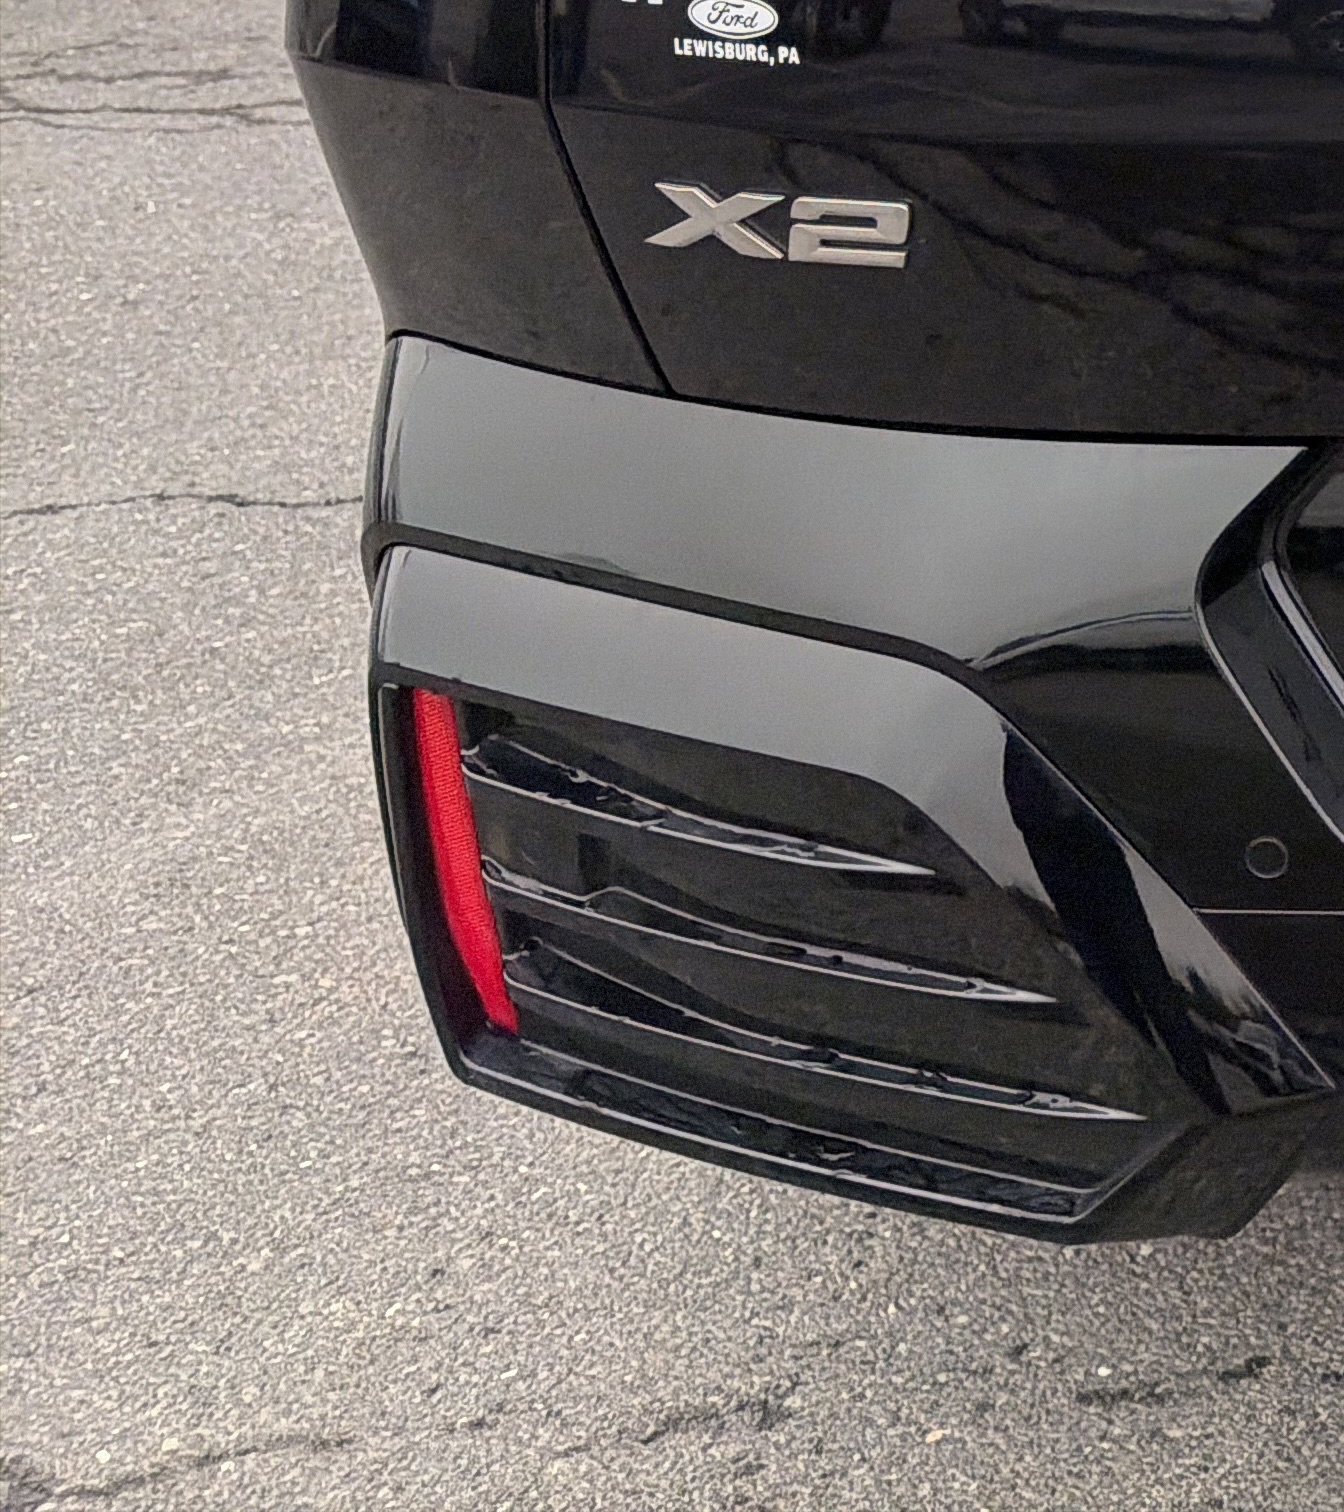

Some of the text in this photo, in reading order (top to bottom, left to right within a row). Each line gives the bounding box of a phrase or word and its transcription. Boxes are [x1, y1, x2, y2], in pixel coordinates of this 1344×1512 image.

[706, 0, 759, 30] Ford
[673, 37, 801, 66] LEWISBURG, PA
[643, 181, 913, 269] X2
